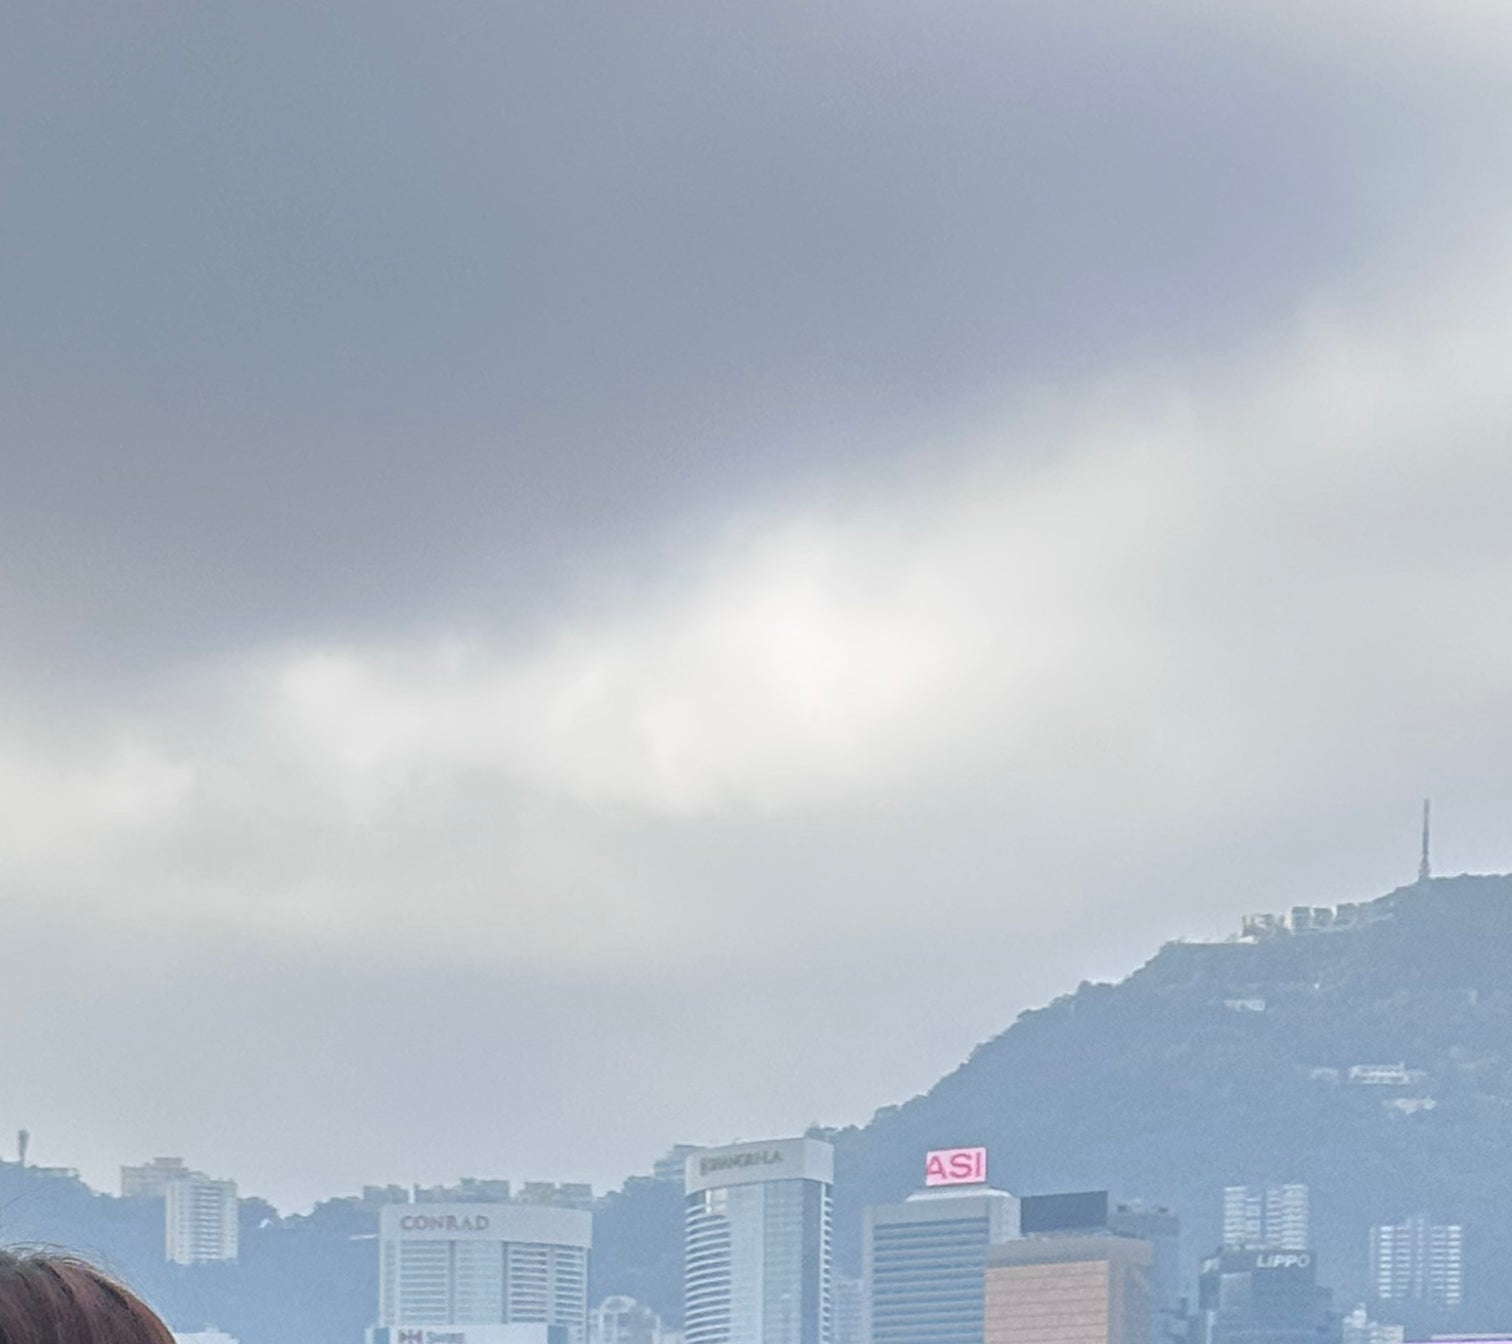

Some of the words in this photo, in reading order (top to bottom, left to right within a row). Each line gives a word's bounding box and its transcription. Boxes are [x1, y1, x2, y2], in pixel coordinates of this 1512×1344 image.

[926, 1151, 982, 1179] ASI
[400, 1215, 488, 1231] CONRAD
[1256, 1253, 1310, 1268] LIPPO
